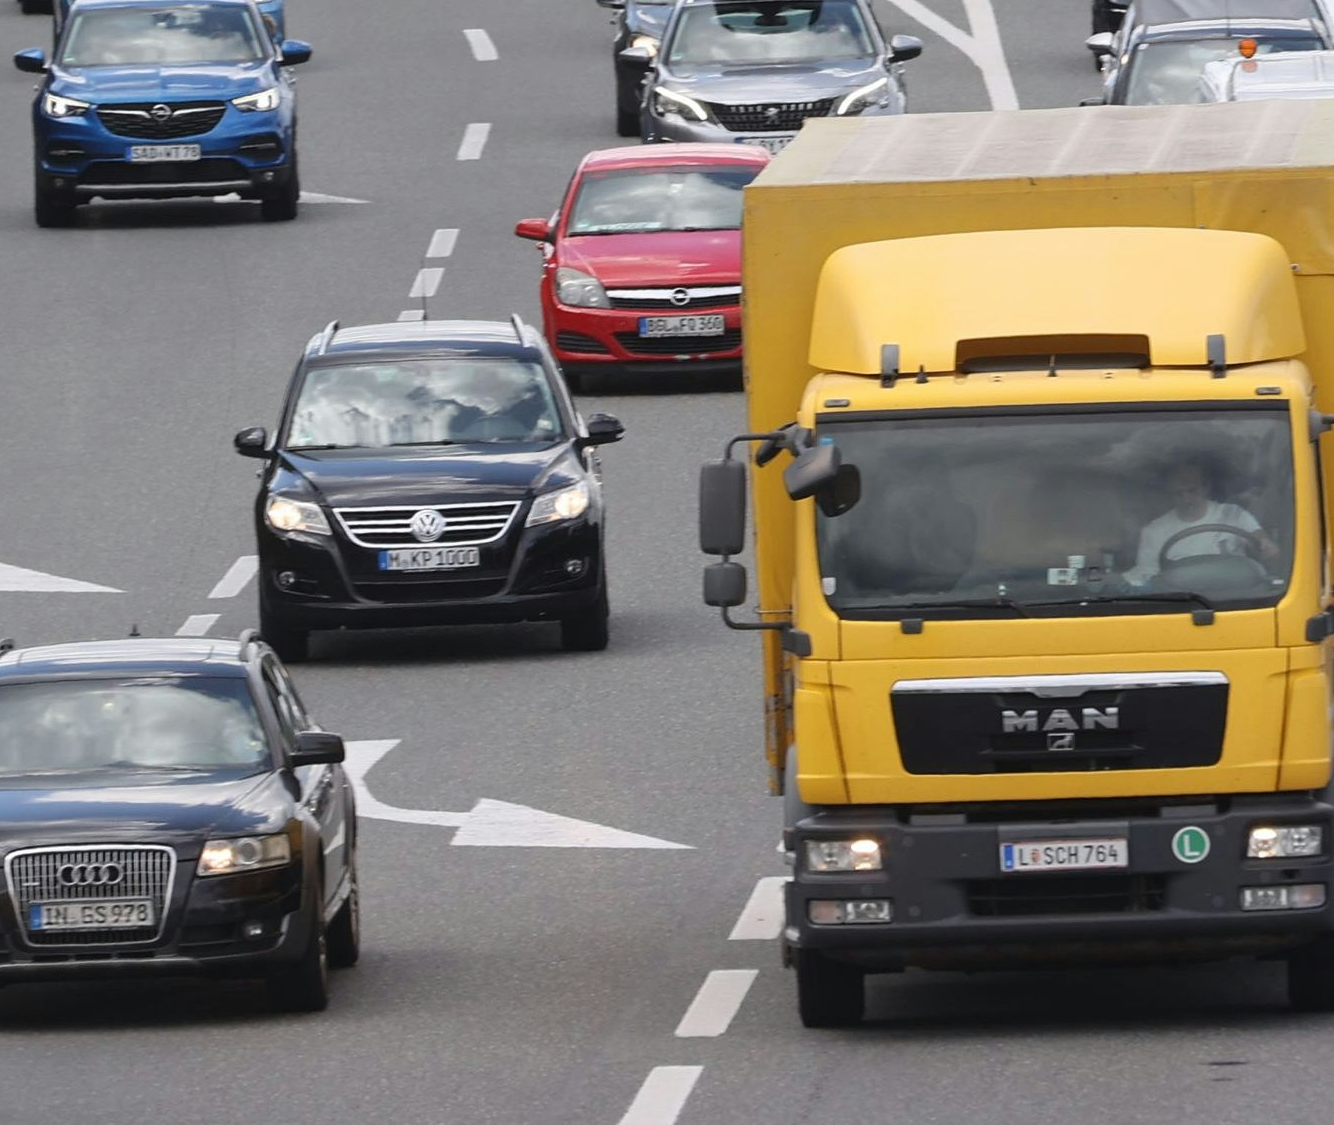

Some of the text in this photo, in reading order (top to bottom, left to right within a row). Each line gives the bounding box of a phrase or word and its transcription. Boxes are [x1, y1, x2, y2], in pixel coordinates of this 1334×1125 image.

[390, 553, 399, 567] M
[412, 550, 432, 566] KP
[1002, 707, 1119, 733] MAN
[1019, 845, 1118, 866] L SCH 764
[1183, 834, 1201, 857] L
[45, 907, 67, 926] IN
[110, 903, 148, 923] 978
